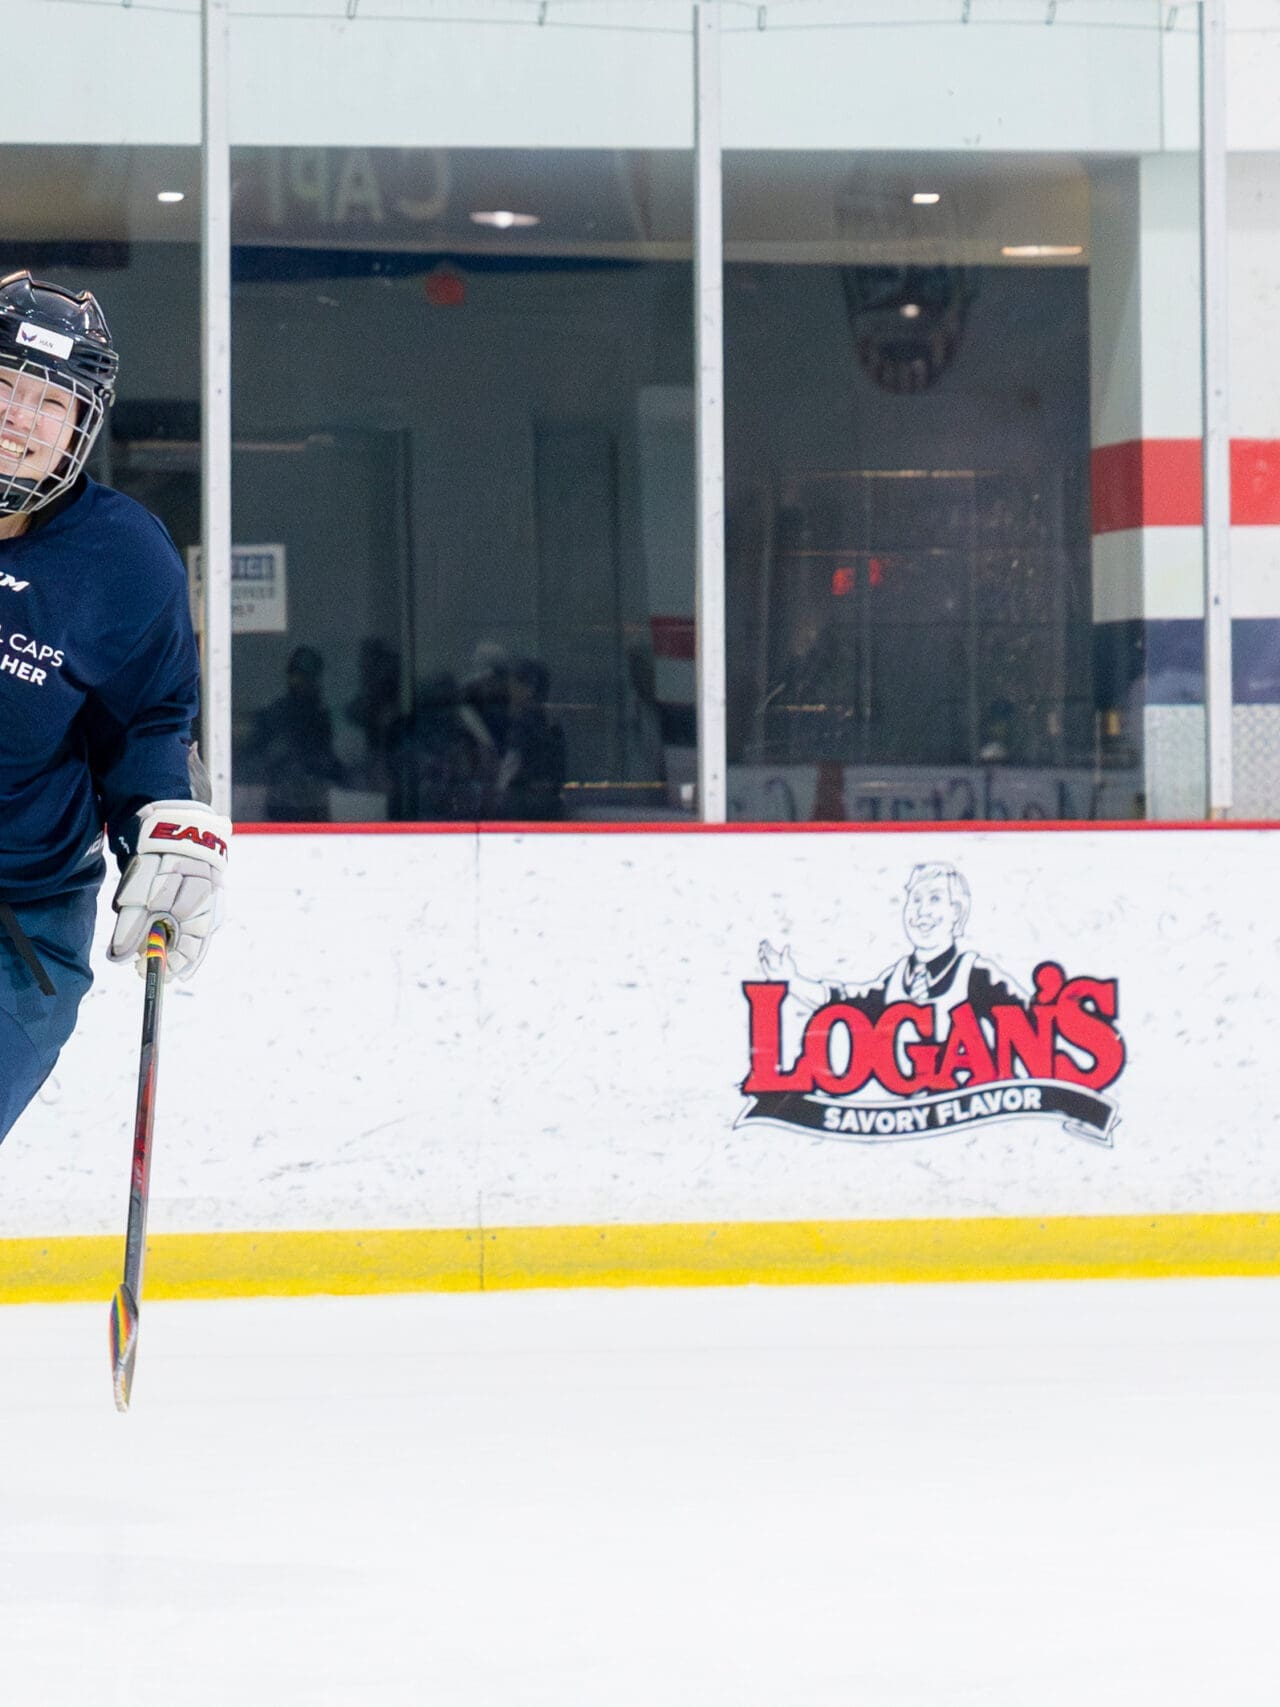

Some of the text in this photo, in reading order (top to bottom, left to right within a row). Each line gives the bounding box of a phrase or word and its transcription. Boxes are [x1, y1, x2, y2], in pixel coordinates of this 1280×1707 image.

[0, 654, 48, 686] HER
[9, 633, 65, 667] CAPS
[742, 961, 1127, 1096] LOGAN'S
[823, 1087, 1041, 1134] SAVORY FLAVOR
